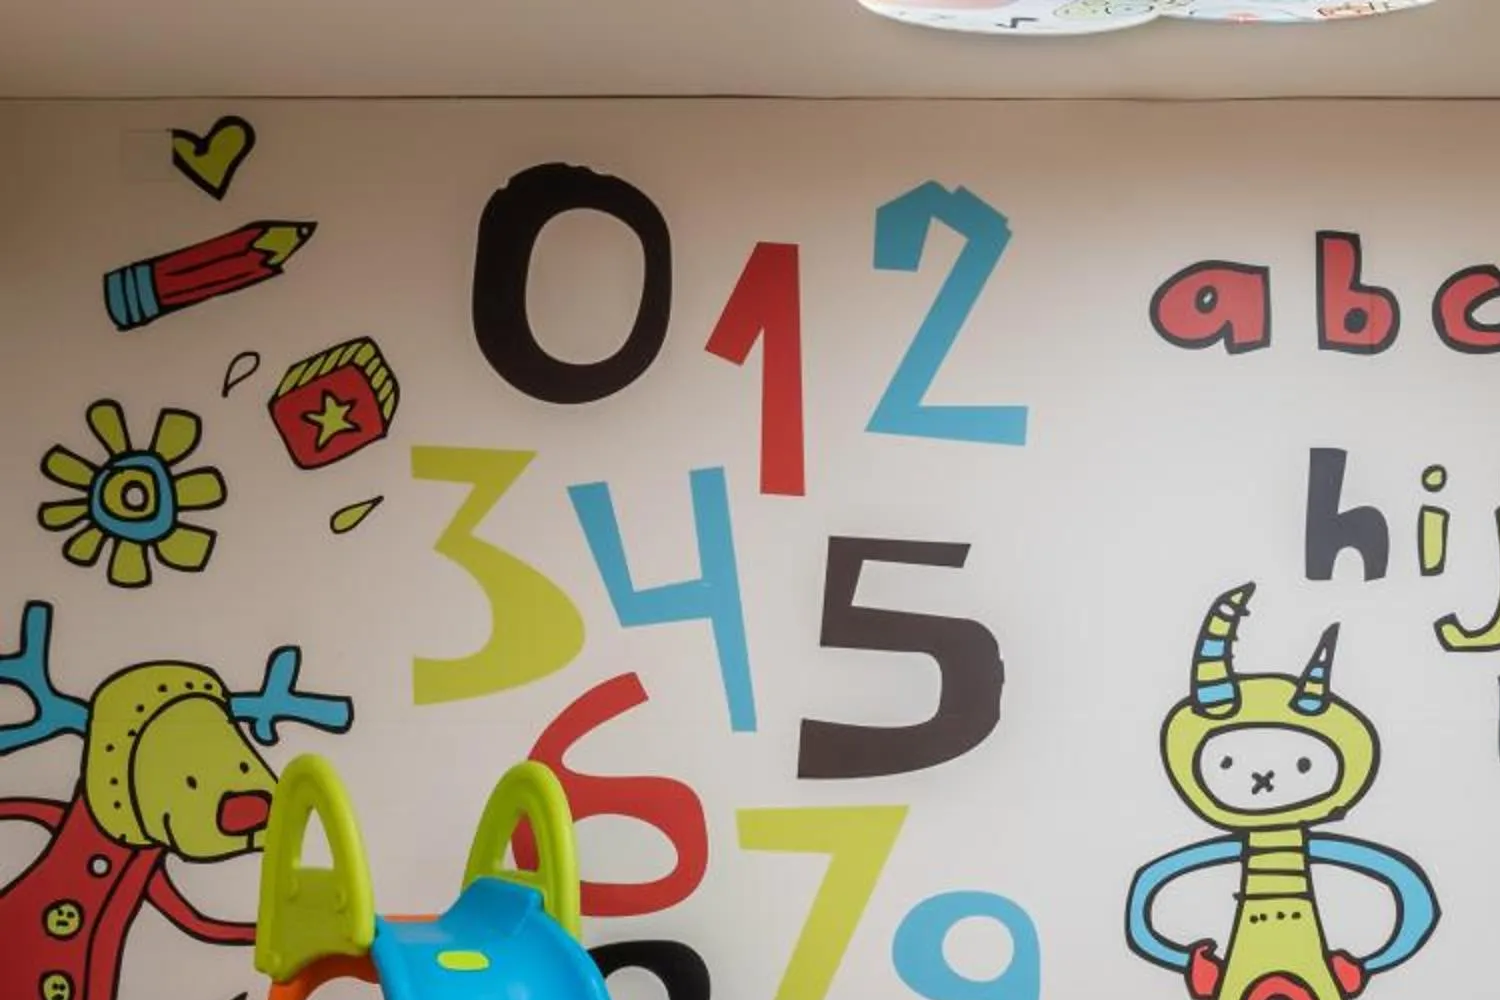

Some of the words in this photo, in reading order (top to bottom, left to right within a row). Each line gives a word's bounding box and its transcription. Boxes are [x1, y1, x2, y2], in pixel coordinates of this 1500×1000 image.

[705, 241, 804, 497] 1
[865, 180, 1029, 446] 2
[1150, 260, 1271, 354] a
[1315, 230, 1400, 355] b
[410, 444, 586, 706] 3
[565, 466, 757, 733] 4
[797, 536, 1005, 780] 5
[1303, 446, 1390, 581] h
[511, 671, 709, 917] 6
